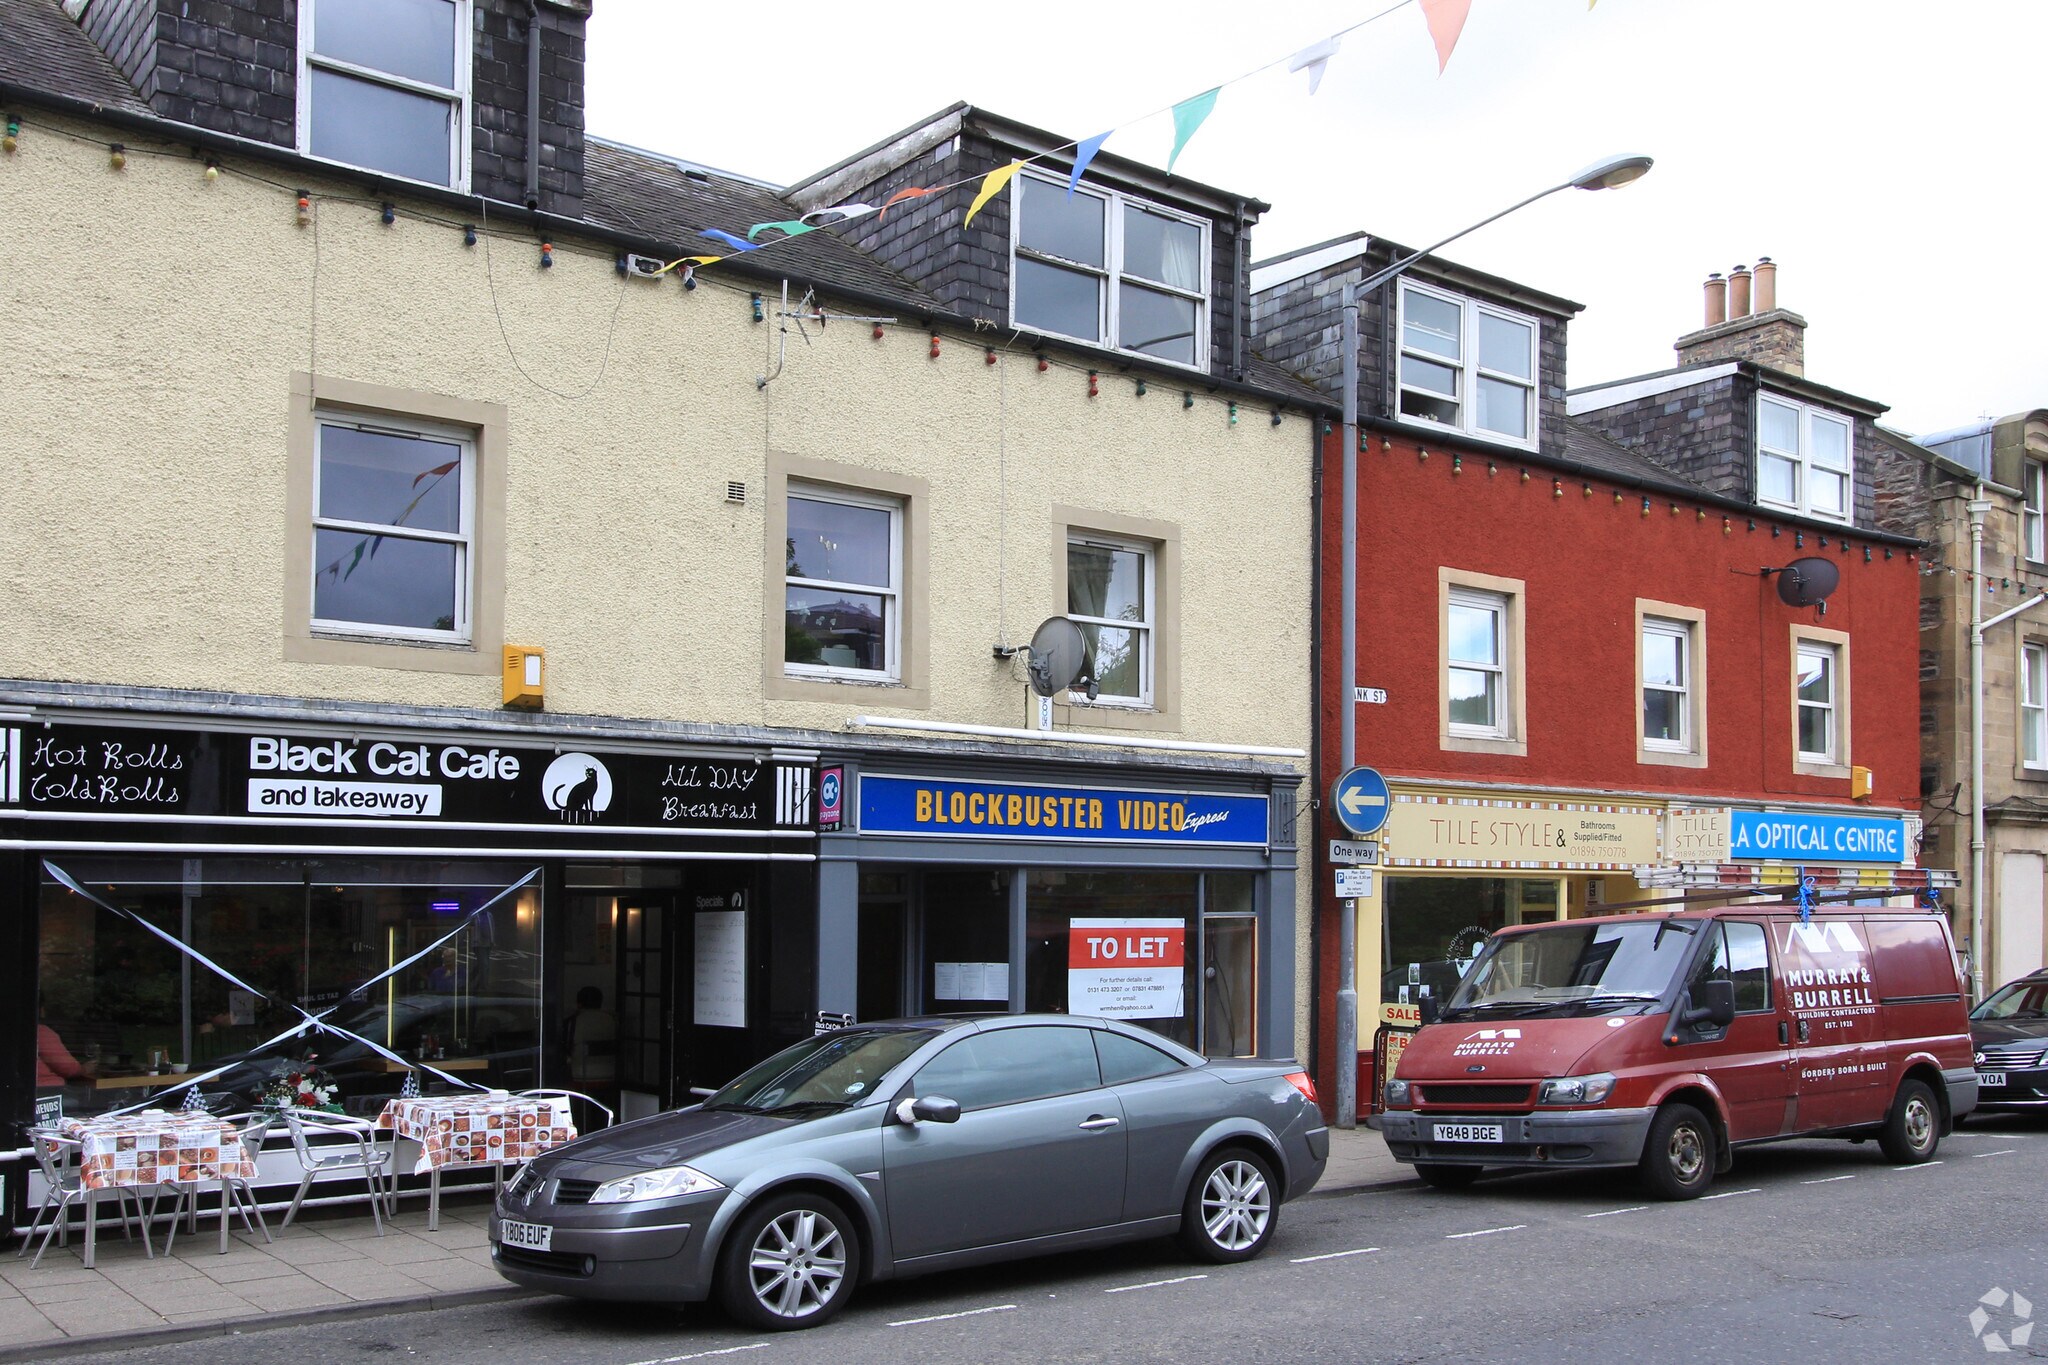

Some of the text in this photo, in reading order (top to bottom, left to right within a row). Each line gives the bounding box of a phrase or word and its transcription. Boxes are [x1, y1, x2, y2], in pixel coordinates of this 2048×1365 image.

[1354, 688, 1384, 702] NK ST
[31, 738, 183, 770] Hot Rolls
[250, 737, 521, 780] Black Cat Cafe
[662, 764, 758, 791] ALL DAY
[31, 773, 179, 803] Cold Rolls
[260, 785, 429, 814] and takeaway
[662, 796, 757, 820] Breakfast
[916, 789, 1230, 833] BLOCKBUSTER VIDEO Express
[1430, 819, 1566, 848] TILE STYLE &
[1580, 820, 1616, 830] Bathrooms
[1675, 816, 1725, 848] TILE STYLE
[1755, 822, 1829, 851] OPTICAL
[1834, 826, 1898, 854] CENTRE
[1333, 845, 1374, 859] One way
[1569, 846, 1627, 858] 01896 750778
[1674, 849, 1724, 858] 01896 750778
[696, 895, 724, 909] Specials
[1086, 937, 1169, 959] TO LET
[1793, 988, 1873, 1008] BURRELL
[1386, 1007, 1421, 1021] SALE
[1798, 1007, 1876, 1019] BUILDING CONTRACTORS
[1825, 1021, 1838, 1029] EST.
[1453, 1048, 1510, 1056] BURRELL
[1801, 1068, 1836, 1078] BORDERS
[1838, 1065, 1858, 1074] BORN
[1866, 1062, 1887, 1071] BUILT
[1981, 1074, 2004, 1084] VOA
[1439, 1126, 1497, 1140] Y848 BGE
[505, 1221, 548, 1245] YB06 EUF
